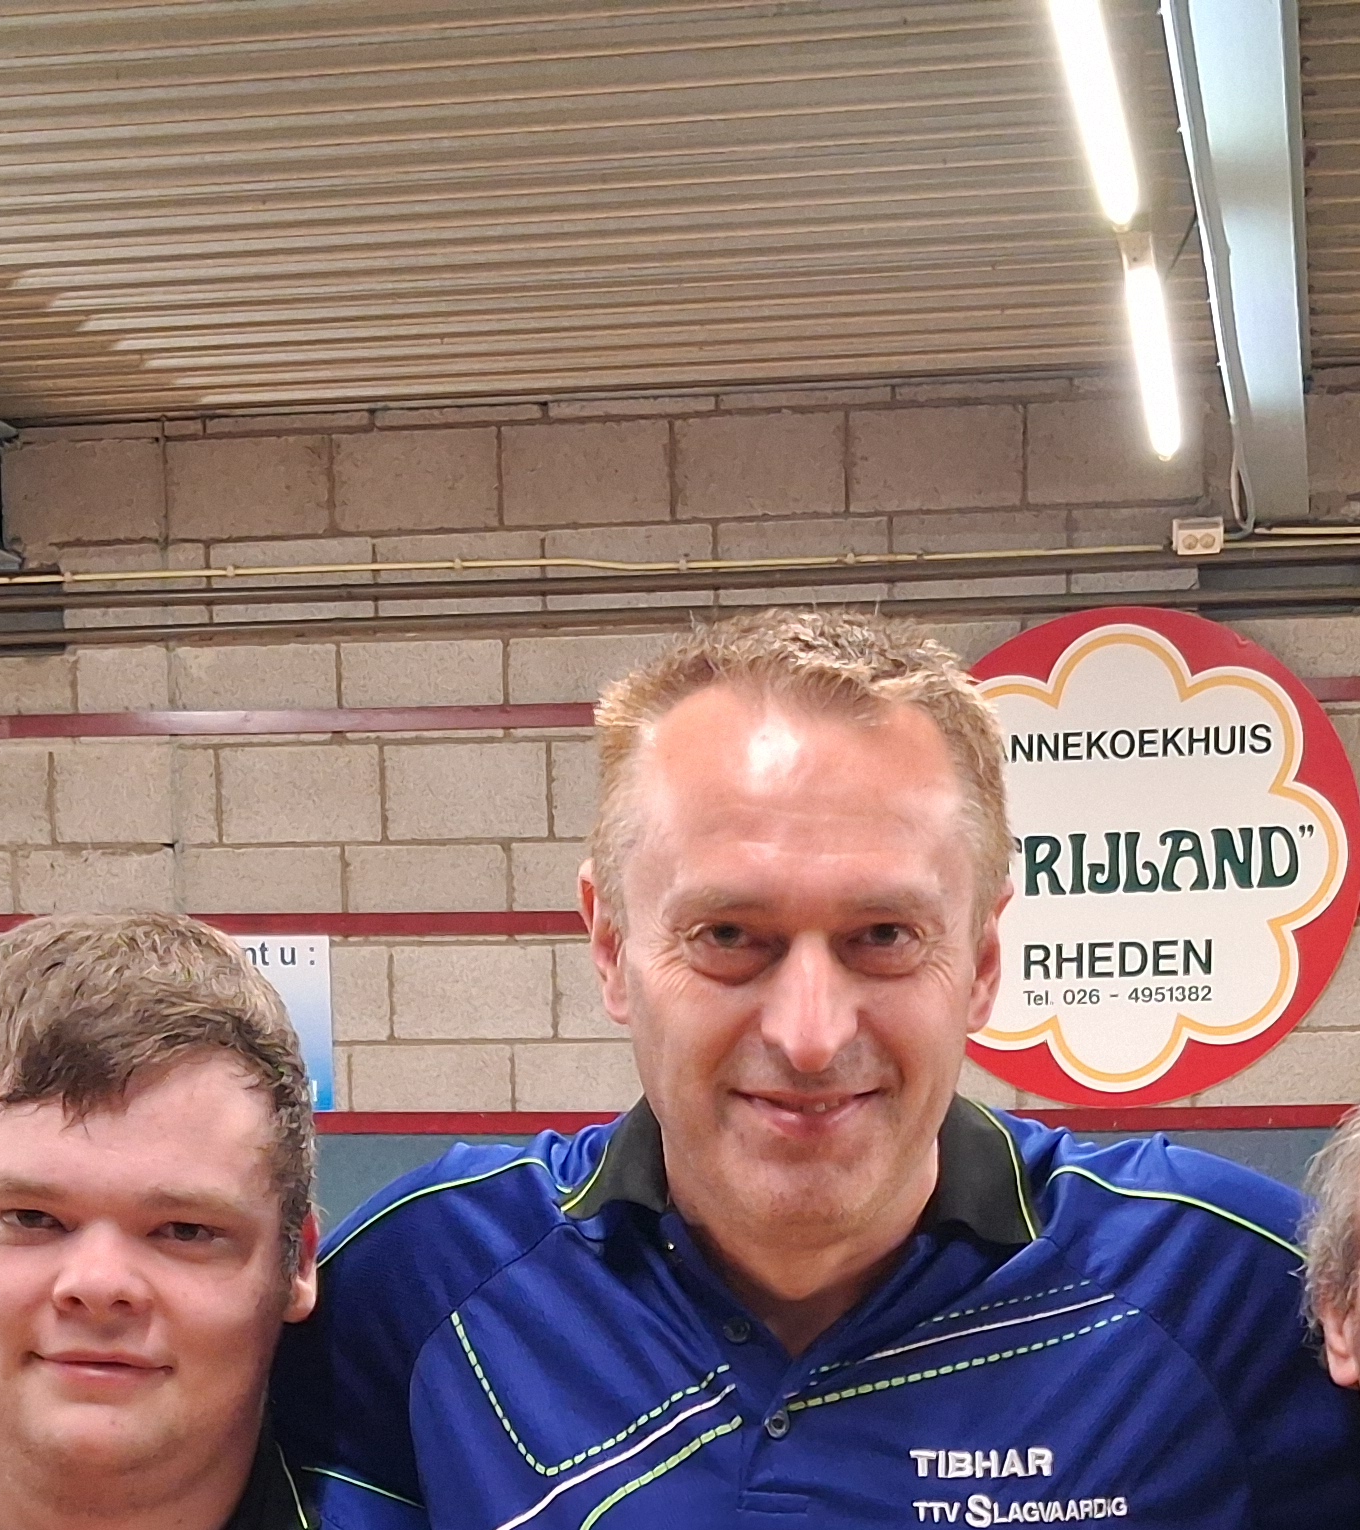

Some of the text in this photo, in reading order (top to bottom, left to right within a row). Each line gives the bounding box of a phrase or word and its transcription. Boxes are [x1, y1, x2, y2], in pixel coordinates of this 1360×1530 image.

[1014, 824, 1314, 897] RIJLAND”
[280, 947, 296, 966] u
[1023, 939, 1213, 980] RHEDEN
[1023, 990, 1054, 1006] Tel.
[1062, 988, 1100, 1006] 026
[1128, 985, 1213, 1003] 4951382
[909, 1447, 1054, 1478] TIBHAR
[912, 1501, 961, 1523] TTV
